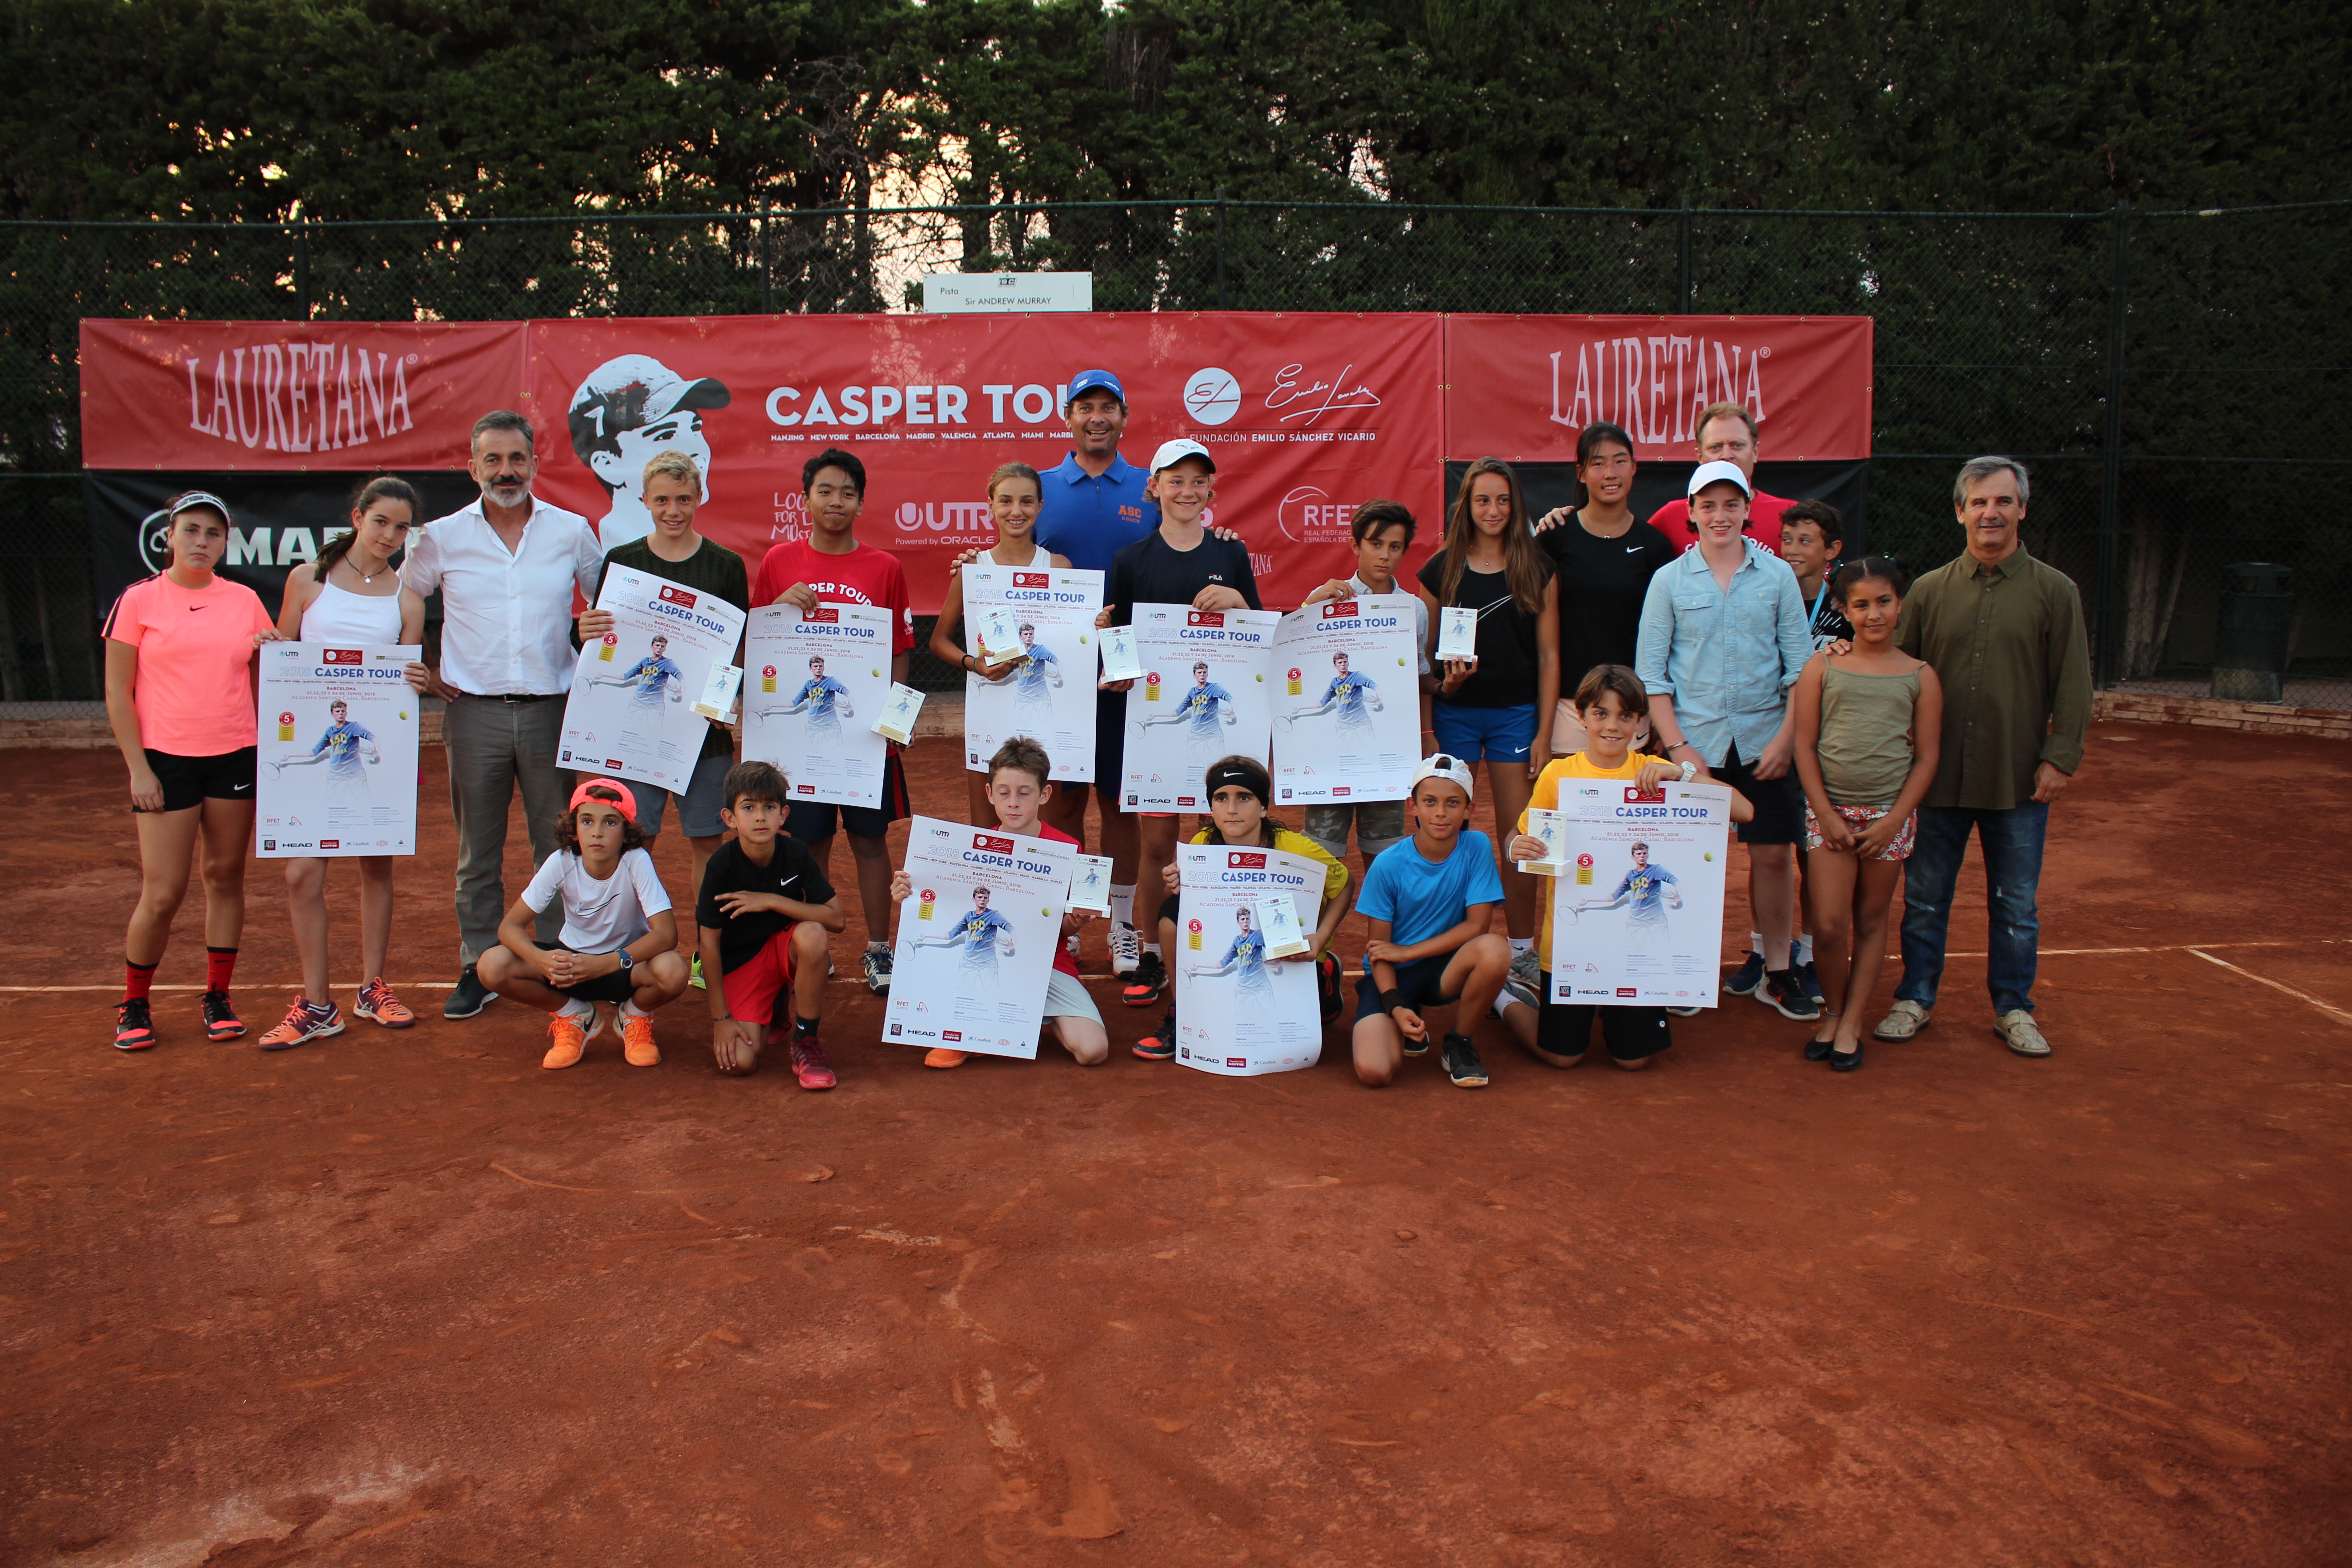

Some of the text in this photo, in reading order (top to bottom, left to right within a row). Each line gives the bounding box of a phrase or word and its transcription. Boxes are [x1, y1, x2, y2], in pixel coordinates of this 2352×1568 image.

[765, 384, 1069, 426] CASPER TO
[1190, 432, 1375, 443] FUNDACIÓN EMILIO SÁNCHEZ VICARIO
[774, 510, 798, 523] POR
[926, 502, 995, 531] UTR
[1118, 505, 1142, 518] ASC
[930, 538, 938, 546] by
[941, 536, 995, 544] ORACLE
[808, 582, 836, 593] PER
[976, 588, 1085, 603] 2018 CASPER TOUR
[617, 591, 725, 635] 2018 CASPER TOUR
[654, 620, 681, 631] BARCELONA
[764, 624, 875, 638] 2018 CASPER TOUR
[1288, 617, 1397, 638] 2018 CASPER TOUR
[1149, 628, 1260, 642] 2018 CASPER TOUR
[280, 666, 402, 679] 2018 CASPER TOUR
[284, 715, 290, 723] 5
[1579, 805, 1708, 818] 2018 CASPER TOUR
[927, 845, 1052, 875] 2018 CASPER TOUR
[972, 872, 1002, 880] BARCELONA
[1189, 871, 1304, 886] 2018 CASPER TOUR
[1194, 1054, 1219, 1063] HEAD
